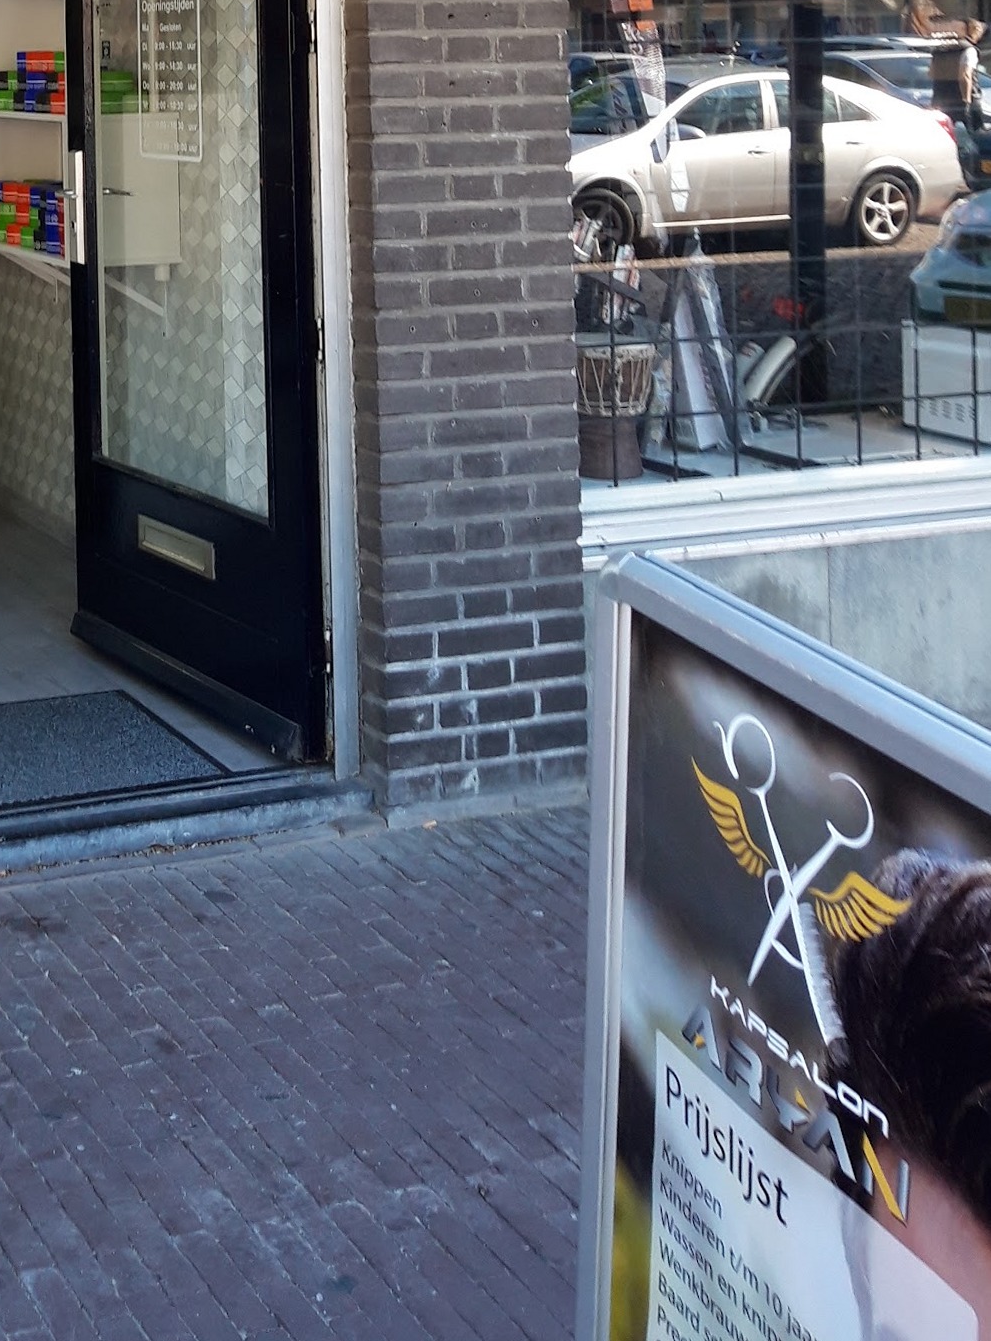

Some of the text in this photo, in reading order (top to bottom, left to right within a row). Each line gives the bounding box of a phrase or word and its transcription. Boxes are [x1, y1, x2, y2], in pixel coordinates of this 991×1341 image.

[141, 22, 182, 33] Ma Gesloten
[186, 42, 197, 51] uur
[187, 62, 197, 71] uur
[142, 81, 150, 90] Do
[187, 82, 197, 91] uur
[710, 974, 890, 1139] KAPSALON
[666, 1064, 789, 1227] Prijslijst
[681, 1005, 909, 1227] ARYAN
[661, 1139, 723, 1219] Knippen
[659, 1205, 714, 1281] Wassen
[717, 1273, 738, 1306] en
[659, 1172, 818, 1341] Kinderen t/m 10 jaa
[658, 1270, 700, 1334] Baard
